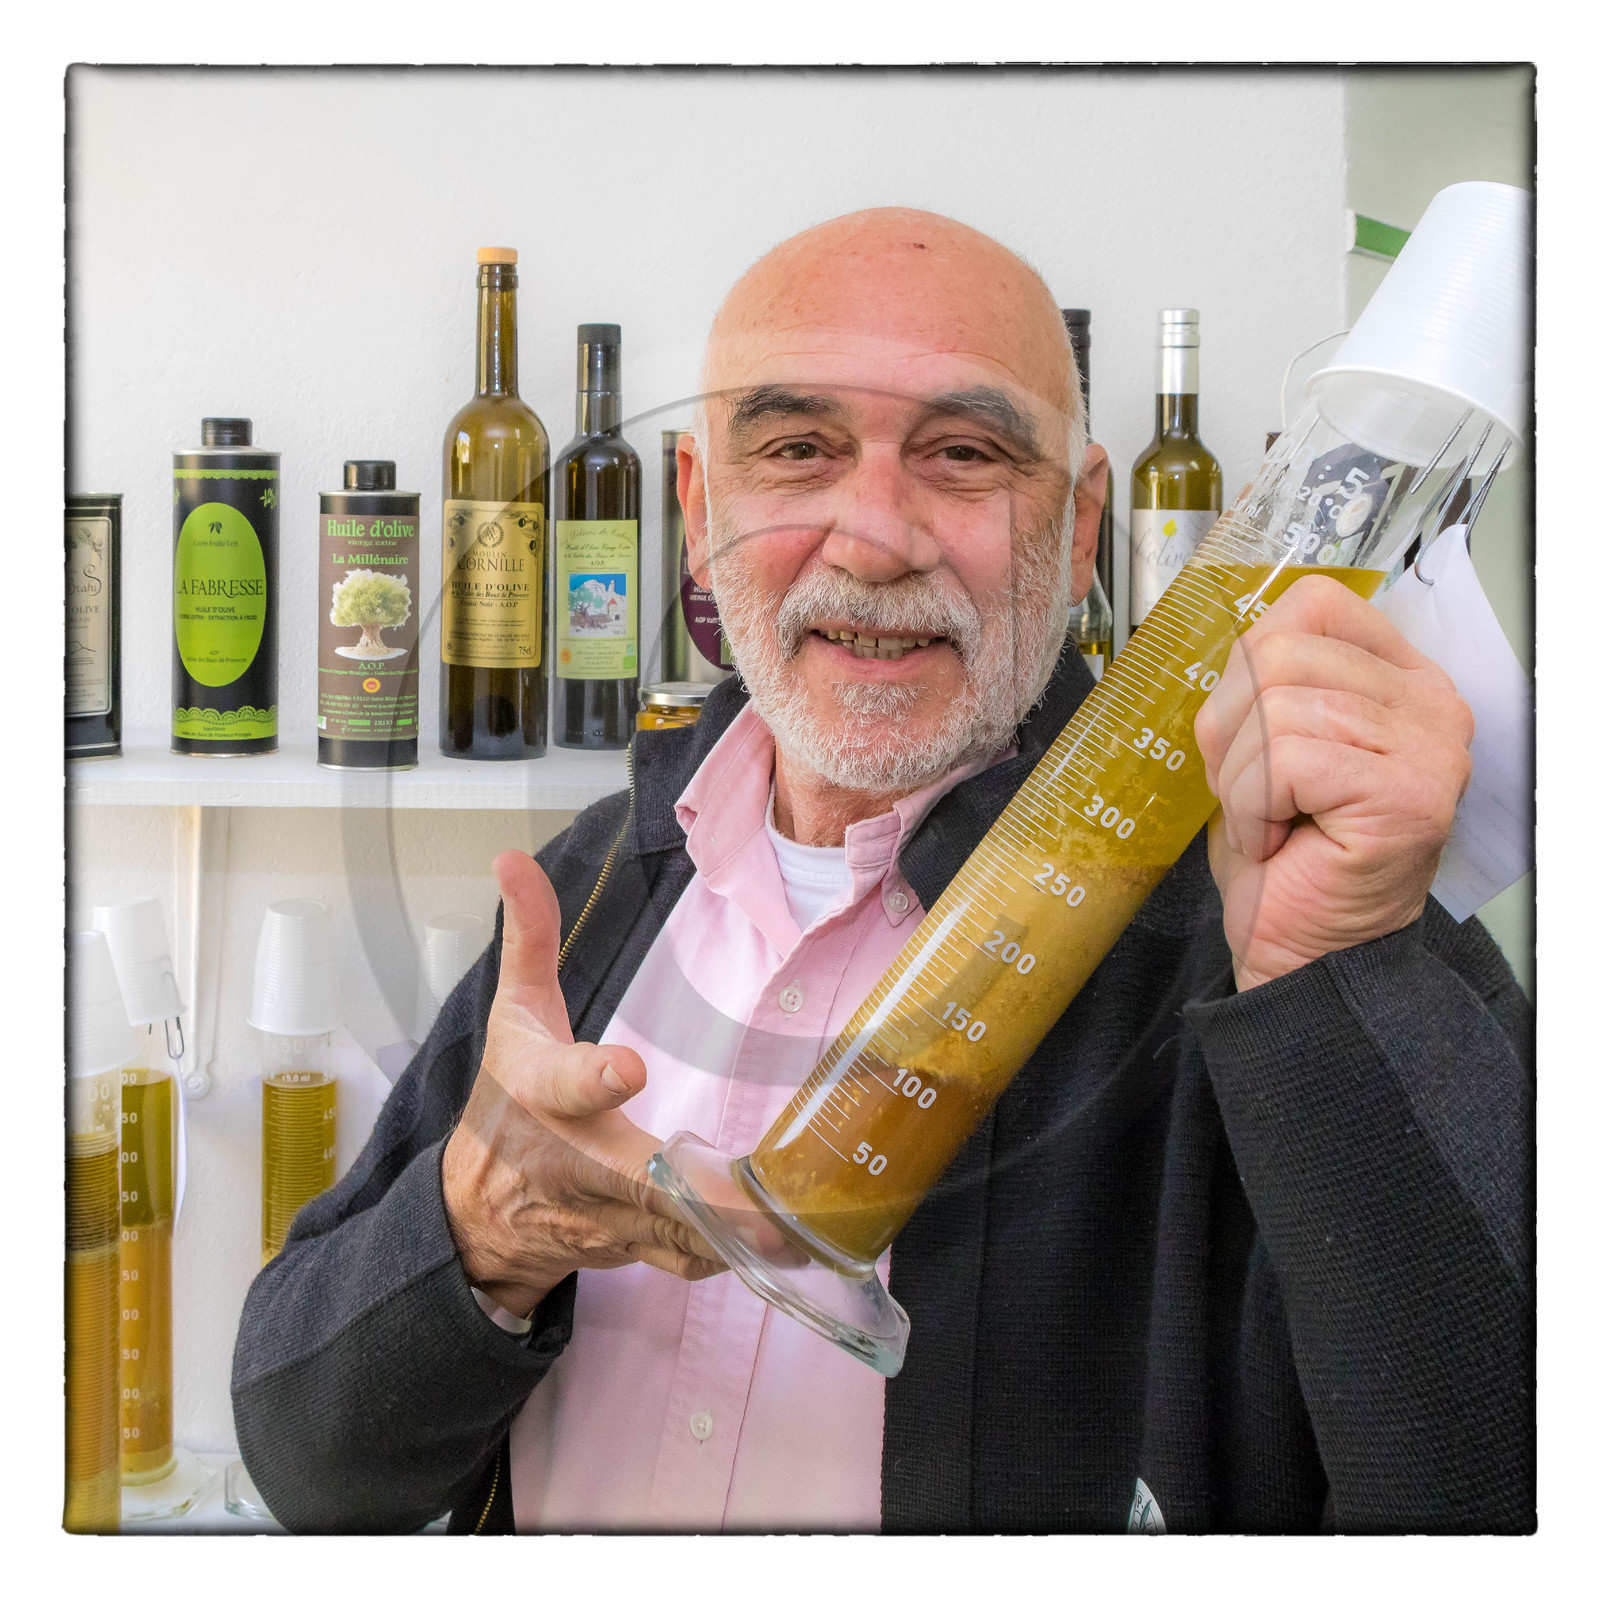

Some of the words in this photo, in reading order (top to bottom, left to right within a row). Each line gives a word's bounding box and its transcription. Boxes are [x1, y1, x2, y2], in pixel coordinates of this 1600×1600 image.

[327, 519, 365, 537] Huile
[370, 519, 414, 538] d'olive
[332, 553, 345, 564] La
[347, 553, 409, 565] Millénaire
[472, 550, 507, 558] MOULIN
[457, 555, 525, 572] CORNILLE
[191, 579, 264, 599] FABRESSE
[451, 581, 481, 591] HUILE
[485, 583, 530, 592] D'OLIVE
[1233, 593, 1271, 624] 45
[358, 662, 386, 670] A.O.P.
[1184, 661, 1220, 692] 40
[1133, 727, 1186, 771] 350
[1083, 795, 1135, 840] 300
[1033, 863, 1086, 907] 250
[984, 930, 1036, 975] 200
[940, 1001, 986, 1043] 150
[121, 1072, 138, 1085] 00
[892, 1068, 937, 1110] 100
[121, 1112, 138, 1124] 50
[121, 1151, 138, 1163] 00
[852, 1141, 888, 1176] 50
[121, 1190, 138, 1202] 50
[122, 1230, 139, 1242] 00
[122, 1269, 139, 1281] 50
[122, 1310, 139, 1321] 00
[122, 1349, 139, 1360] 50
[123, 1388, 140, 1399] 00
